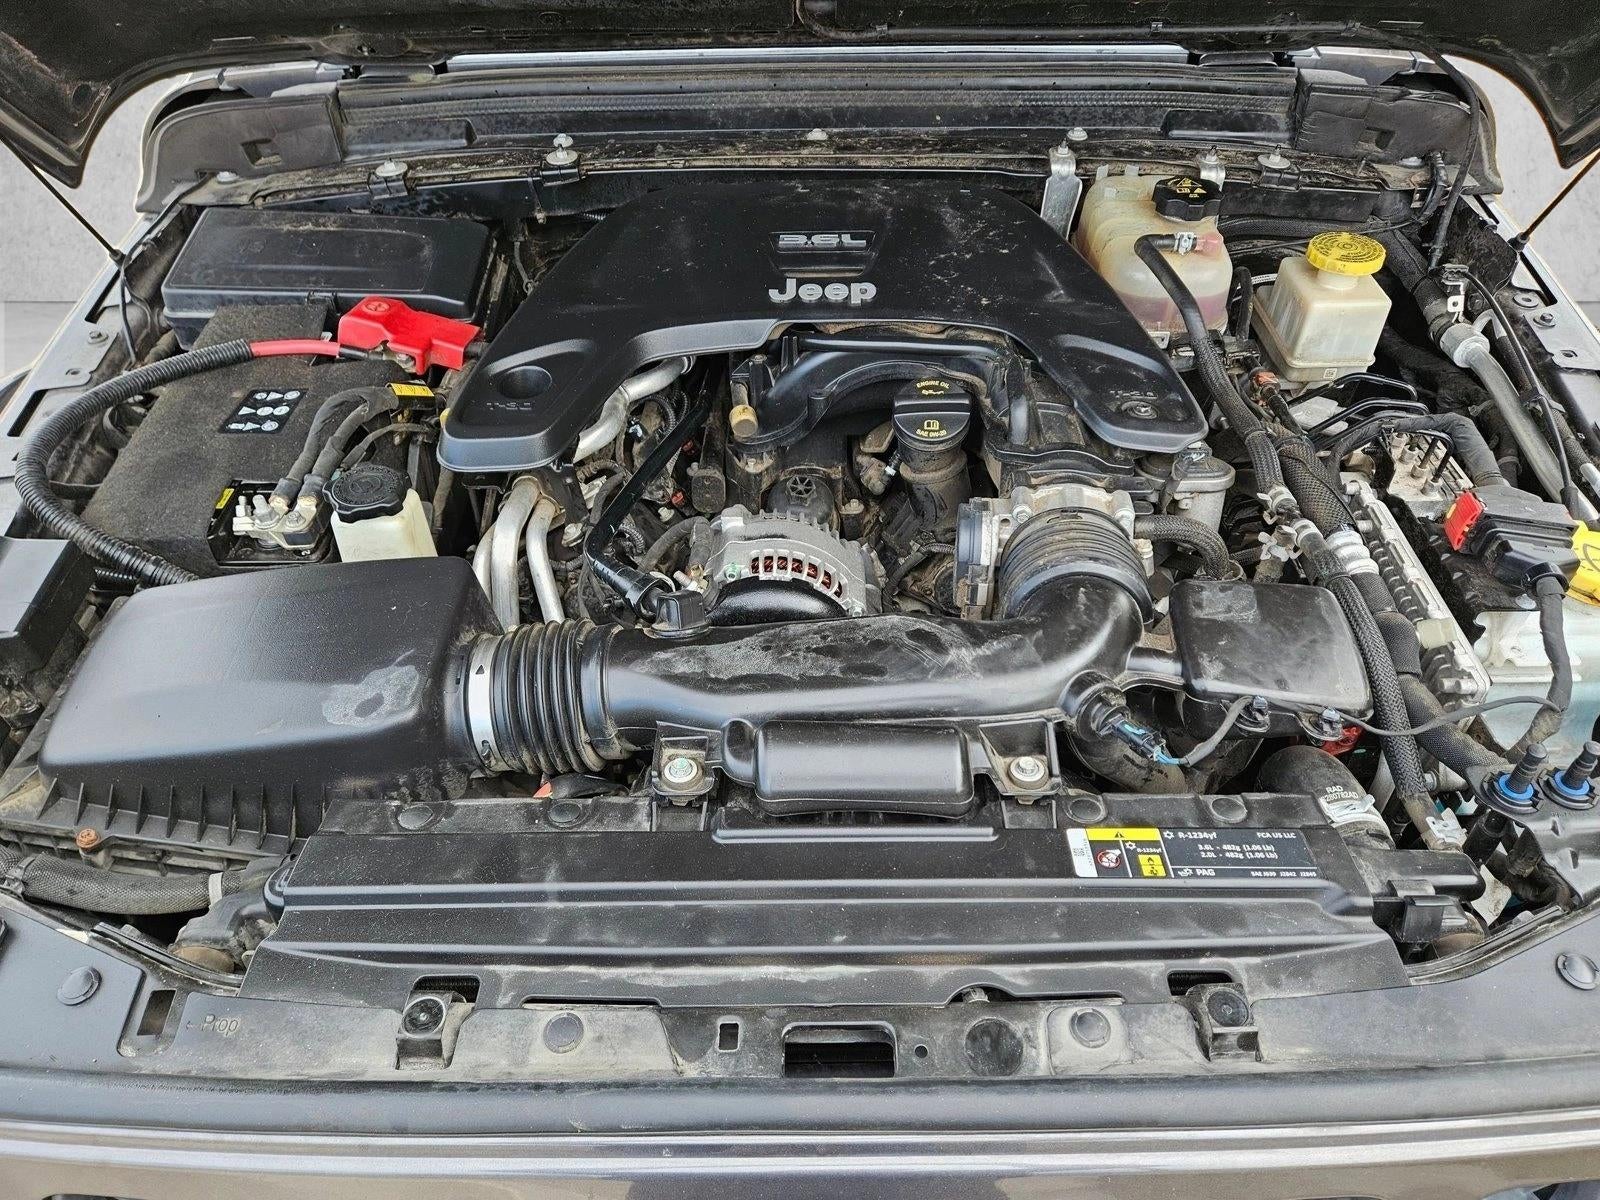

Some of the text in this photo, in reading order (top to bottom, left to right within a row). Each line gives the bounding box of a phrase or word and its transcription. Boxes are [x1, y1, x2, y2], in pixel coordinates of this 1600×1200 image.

[778, 233, 867, 248] 3.6L
[768, 278, 877, 305] Jeep
[916, 380, 950, 389] ENGINE OIL
[915, 428, 929, 437] SAE
[1325, 785, 1344, 794] RAD
[1177, 831, 1218, 840] R-1234yf
[1195, 868, 1216, 876] PAG
[201, 1013, 239, 1037] Prop
